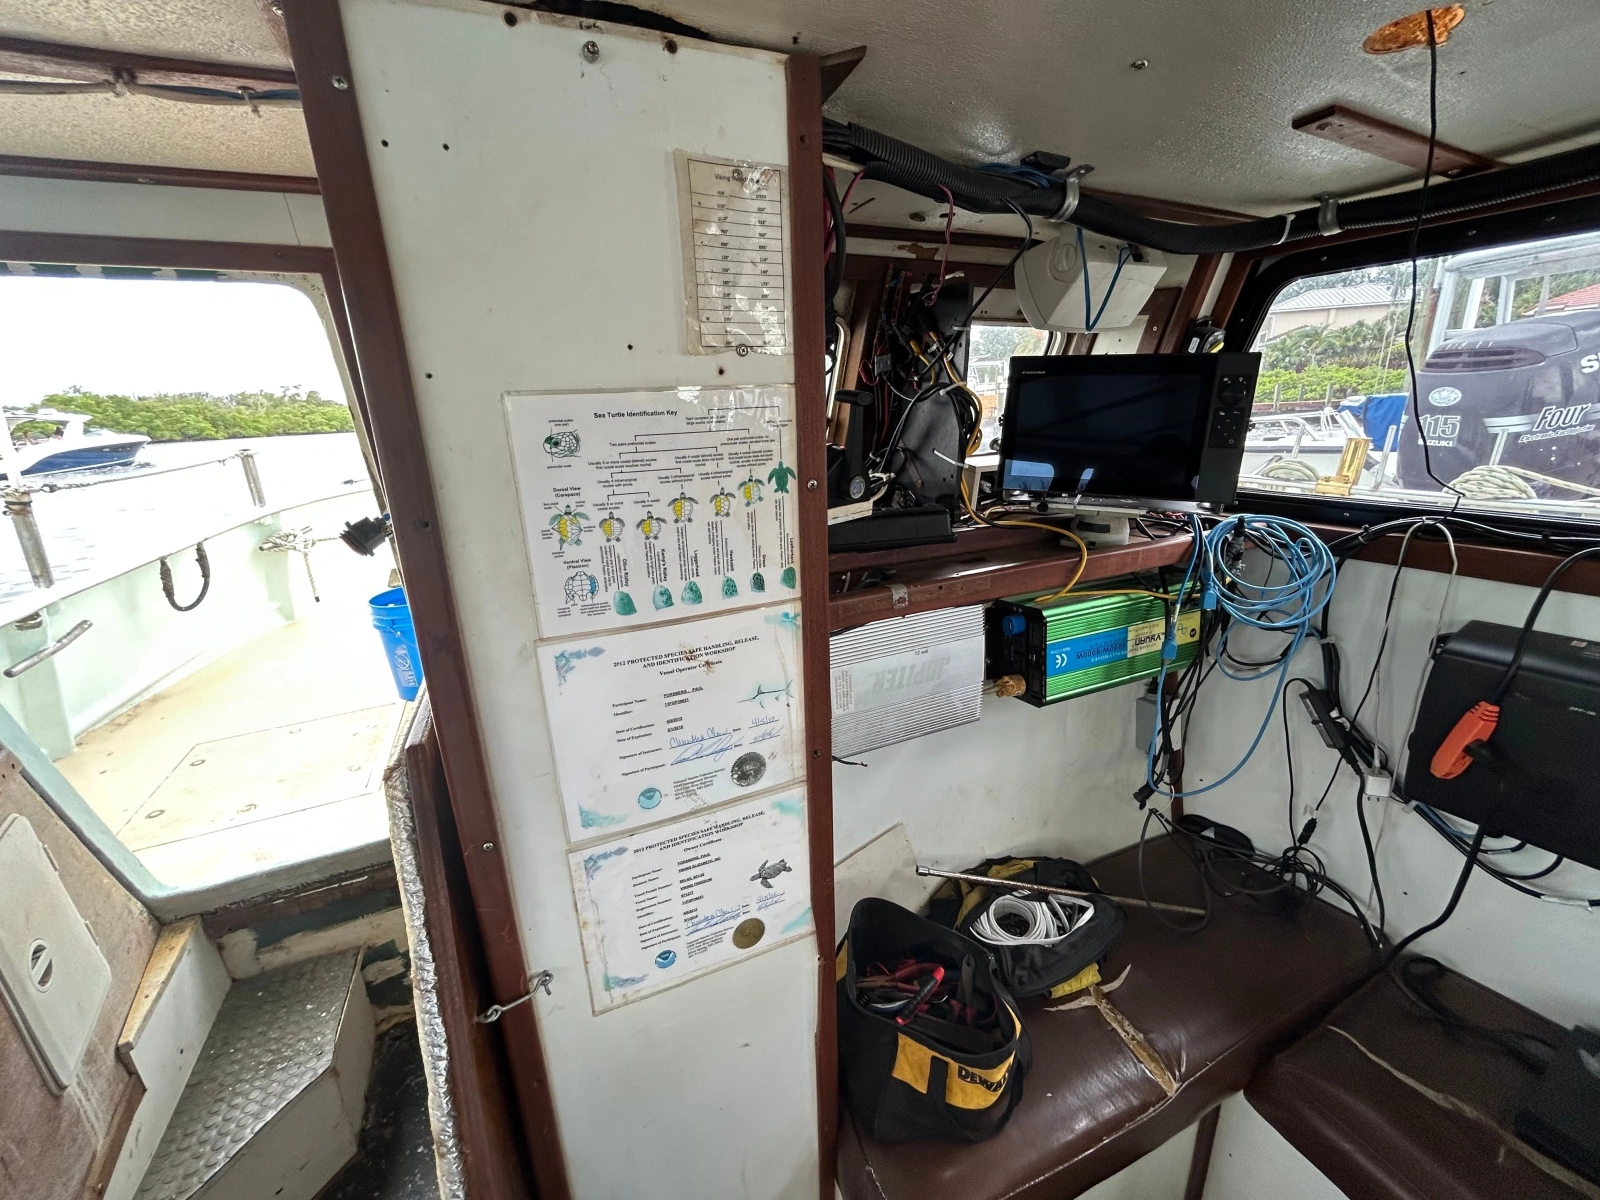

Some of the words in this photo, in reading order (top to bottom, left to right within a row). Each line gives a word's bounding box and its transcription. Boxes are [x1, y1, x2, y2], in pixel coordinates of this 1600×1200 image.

[715, 174, 730, 182] Viking
[1580, 352, 1600, 374] S
[1418, 414, 1460, 437] 115
[1418, 438, 1453, 446] SZUKI
[626, 654, 663, 664] PROTECTED
[703, 641, 733, 650] HANDLING,
[734, 635, 759, 644] RELEASE,
[1135, 633, 1166, 646] VYUAN
[656, 653, 703, 666] IDENTIFICATION
[704, 646, 735, 656] WORKSHOP
[645, 837, 677, 850] PROTECTED
[678, 830, 699, 840] SPECIES
[742, 810, 765, 820] RELEASE,
[671, 831, 713, 847] IDENTIFICATION
[714, 822, 743, 833] WORKSHOP
[699, 838, 721, 847] Certificate
